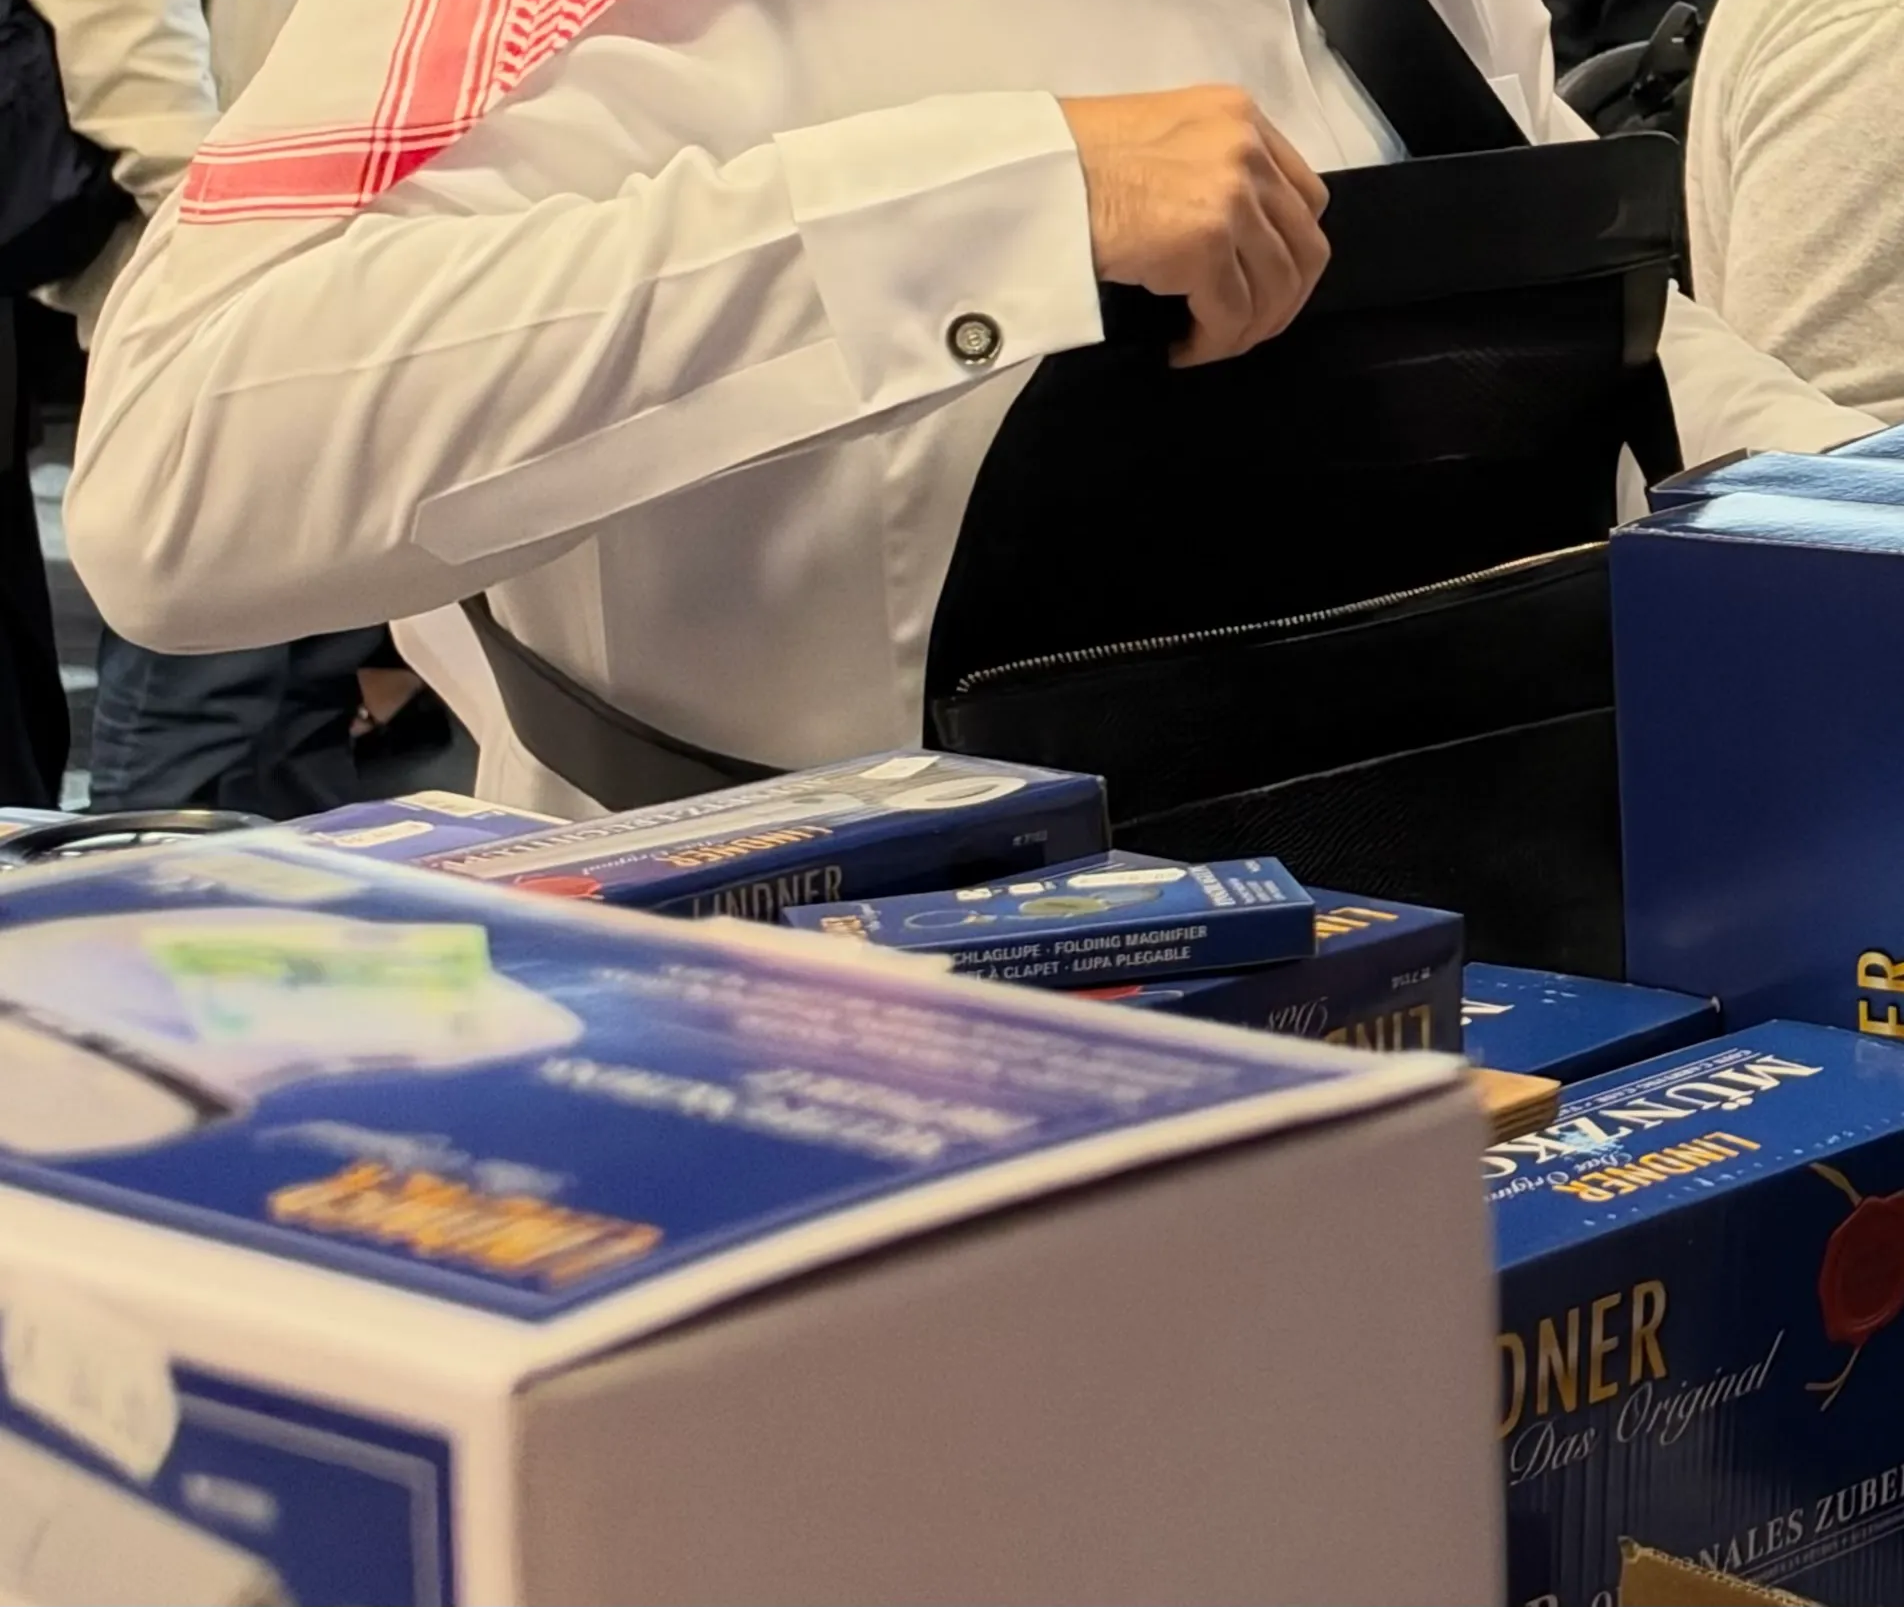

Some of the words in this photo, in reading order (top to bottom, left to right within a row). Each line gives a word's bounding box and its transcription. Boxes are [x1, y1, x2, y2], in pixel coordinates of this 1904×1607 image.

[1004, 960, 1060, 980] CLAPET
[1073, 953, 1112, 974] LUPA
[1116, 945, 1191, 968] PLEGABLE
[1055, 933, 1122, 957] FOLDING
[1125, 924, 1208, 950] MAGNIFIER
[1552, 1131, 1762, 1203] LINDNER
[1509, 1420, 1596, 1486] Das
[1616, 1328, 1785, 1447] Original
